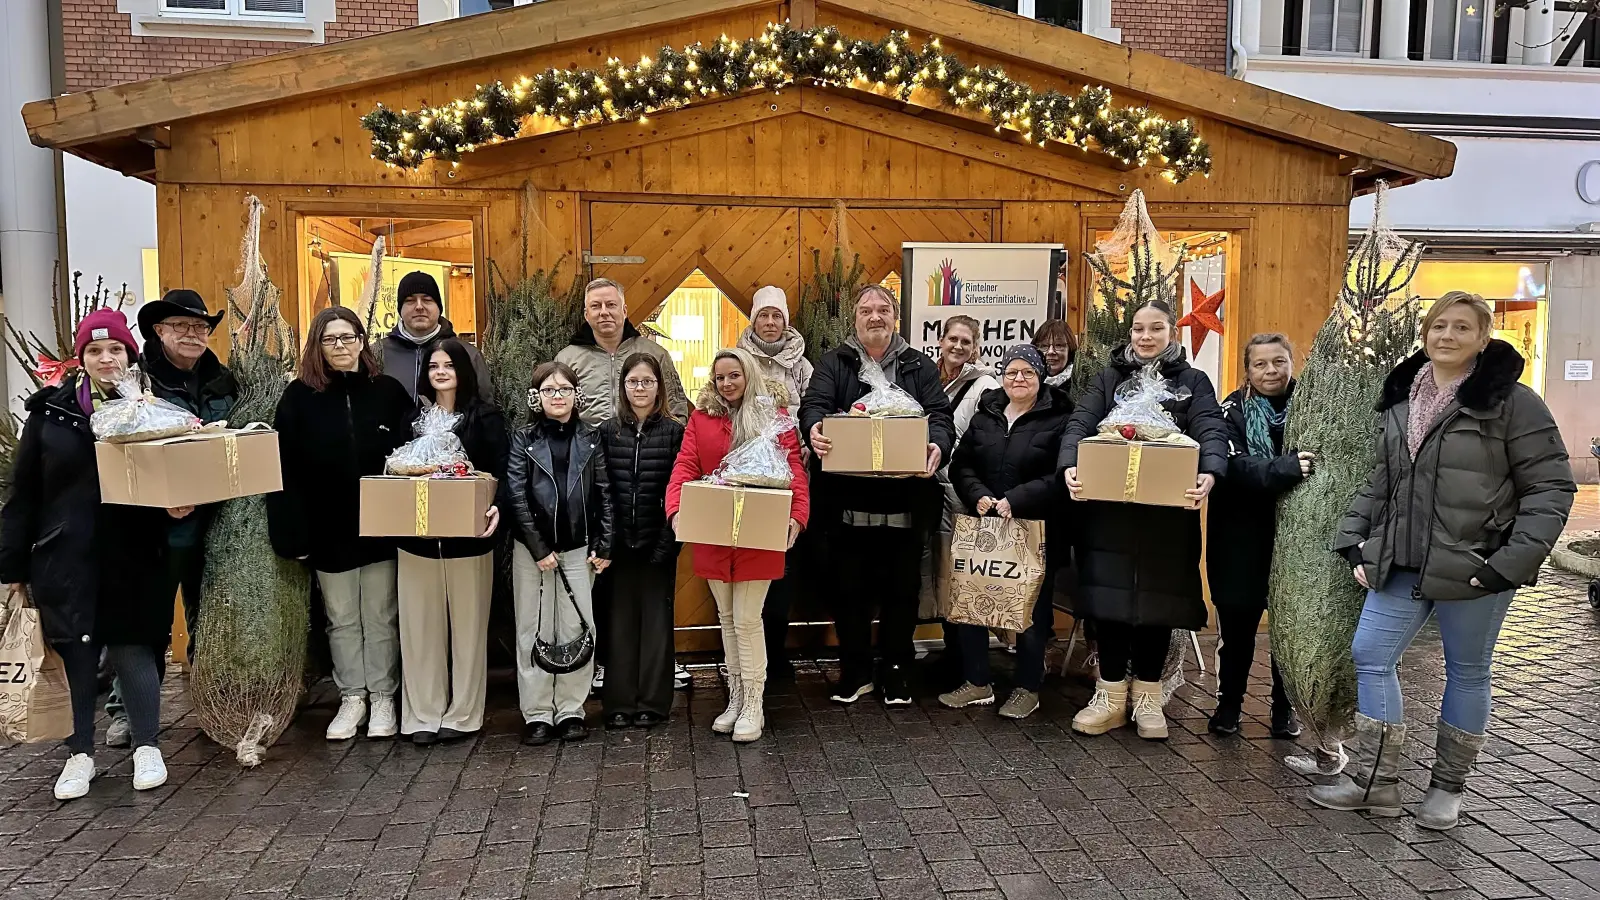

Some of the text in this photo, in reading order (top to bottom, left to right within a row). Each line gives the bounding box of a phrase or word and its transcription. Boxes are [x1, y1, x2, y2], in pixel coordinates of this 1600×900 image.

[965, 282, 998, 292] Rintelner
[114, 290, 136, 306] 19
[965, 293, 1026, 304] Silvesterinitiative
[923, 319, 1035, 341] MHEN
